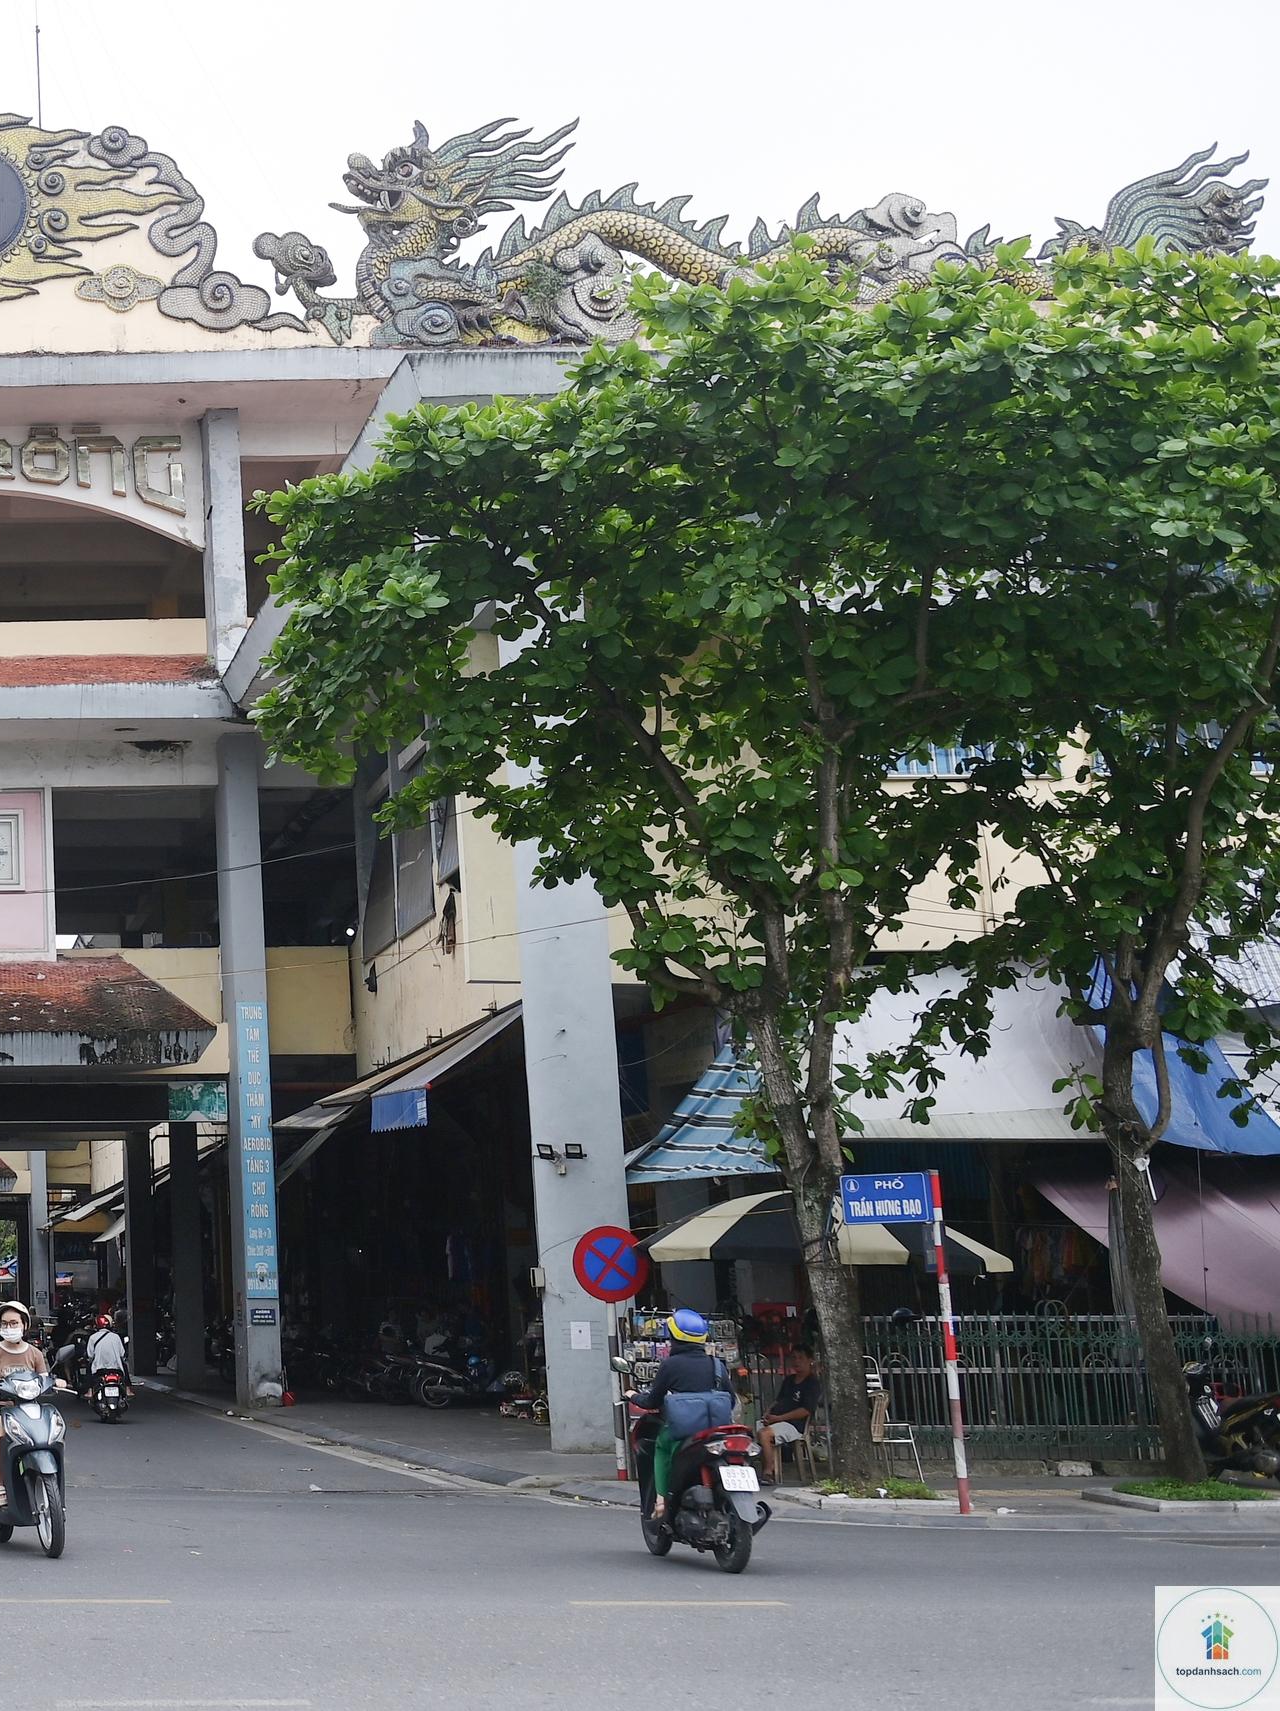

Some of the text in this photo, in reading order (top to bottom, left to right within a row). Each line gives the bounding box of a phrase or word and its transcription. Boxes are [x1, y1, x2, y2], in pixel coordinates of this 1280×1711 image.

[241, 1006, 262, 1020] TRUNG
[243, 1136, 272, 1151] AEROBIC
[265, 1159, 270, 1173] 3
[875, 1176, 904, 1190] PHỐ
[902, 1199, 922, 1218] ĐẠO
